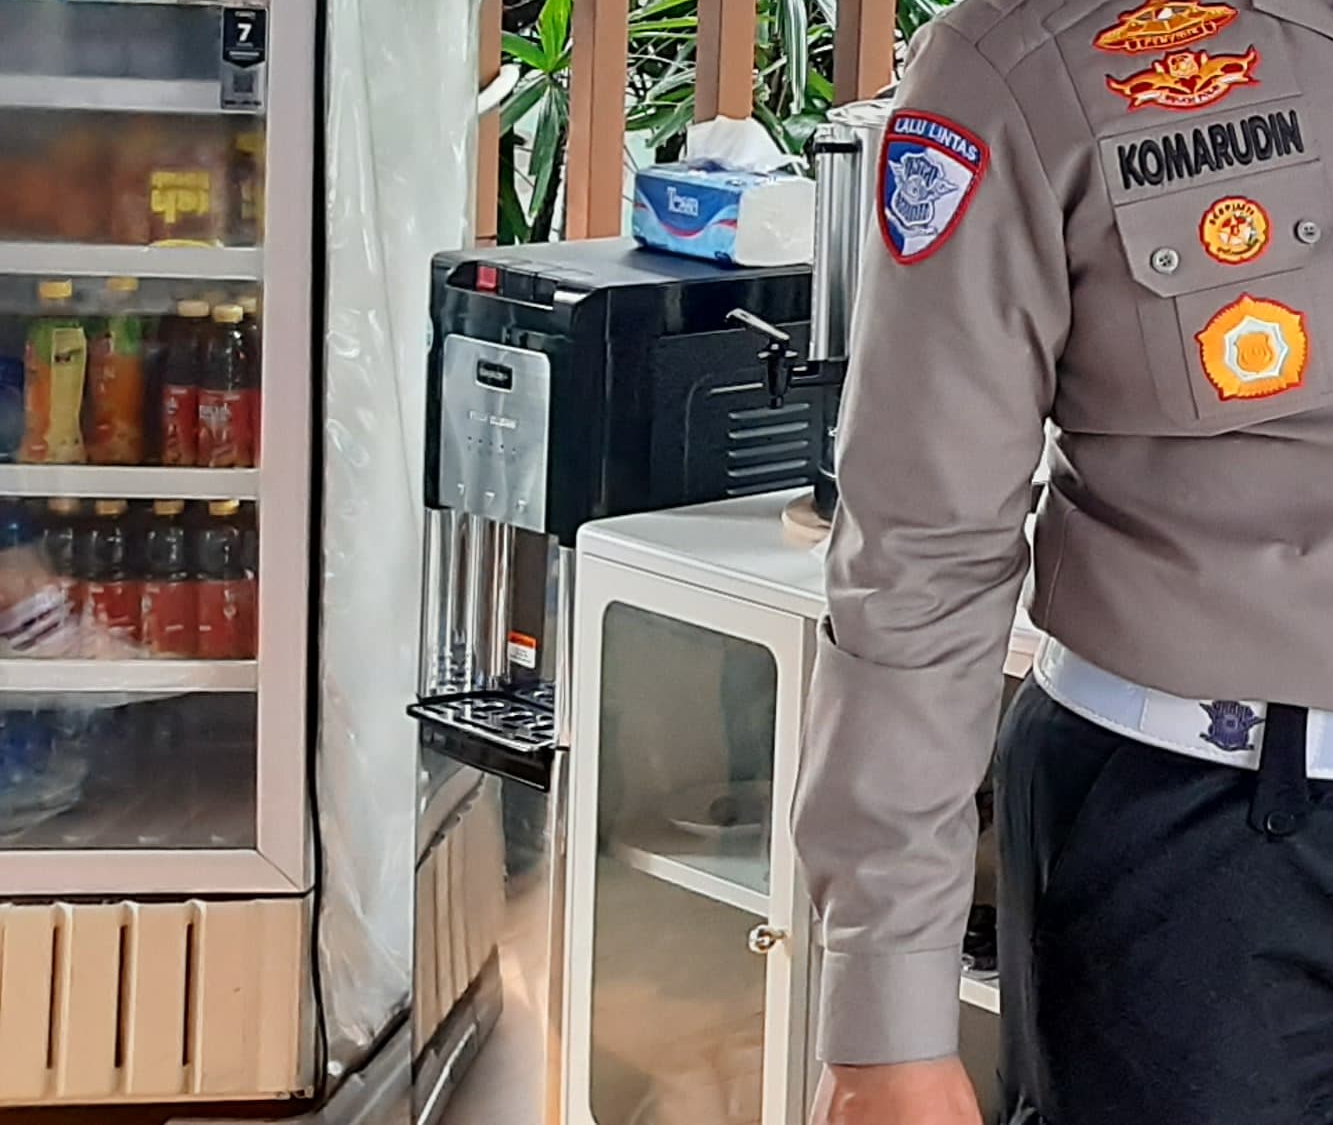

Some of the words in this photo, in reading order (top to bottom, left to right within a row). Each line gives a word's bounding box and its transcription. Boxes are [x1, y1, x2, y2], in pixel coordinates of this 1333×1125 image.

[238, 24, 251, 41] 7
[894, 117, 927, 135] LALU
[928, 122, 978, 161] LINTAS
[1117, 110, 1304, 190] KOMARUDIN
